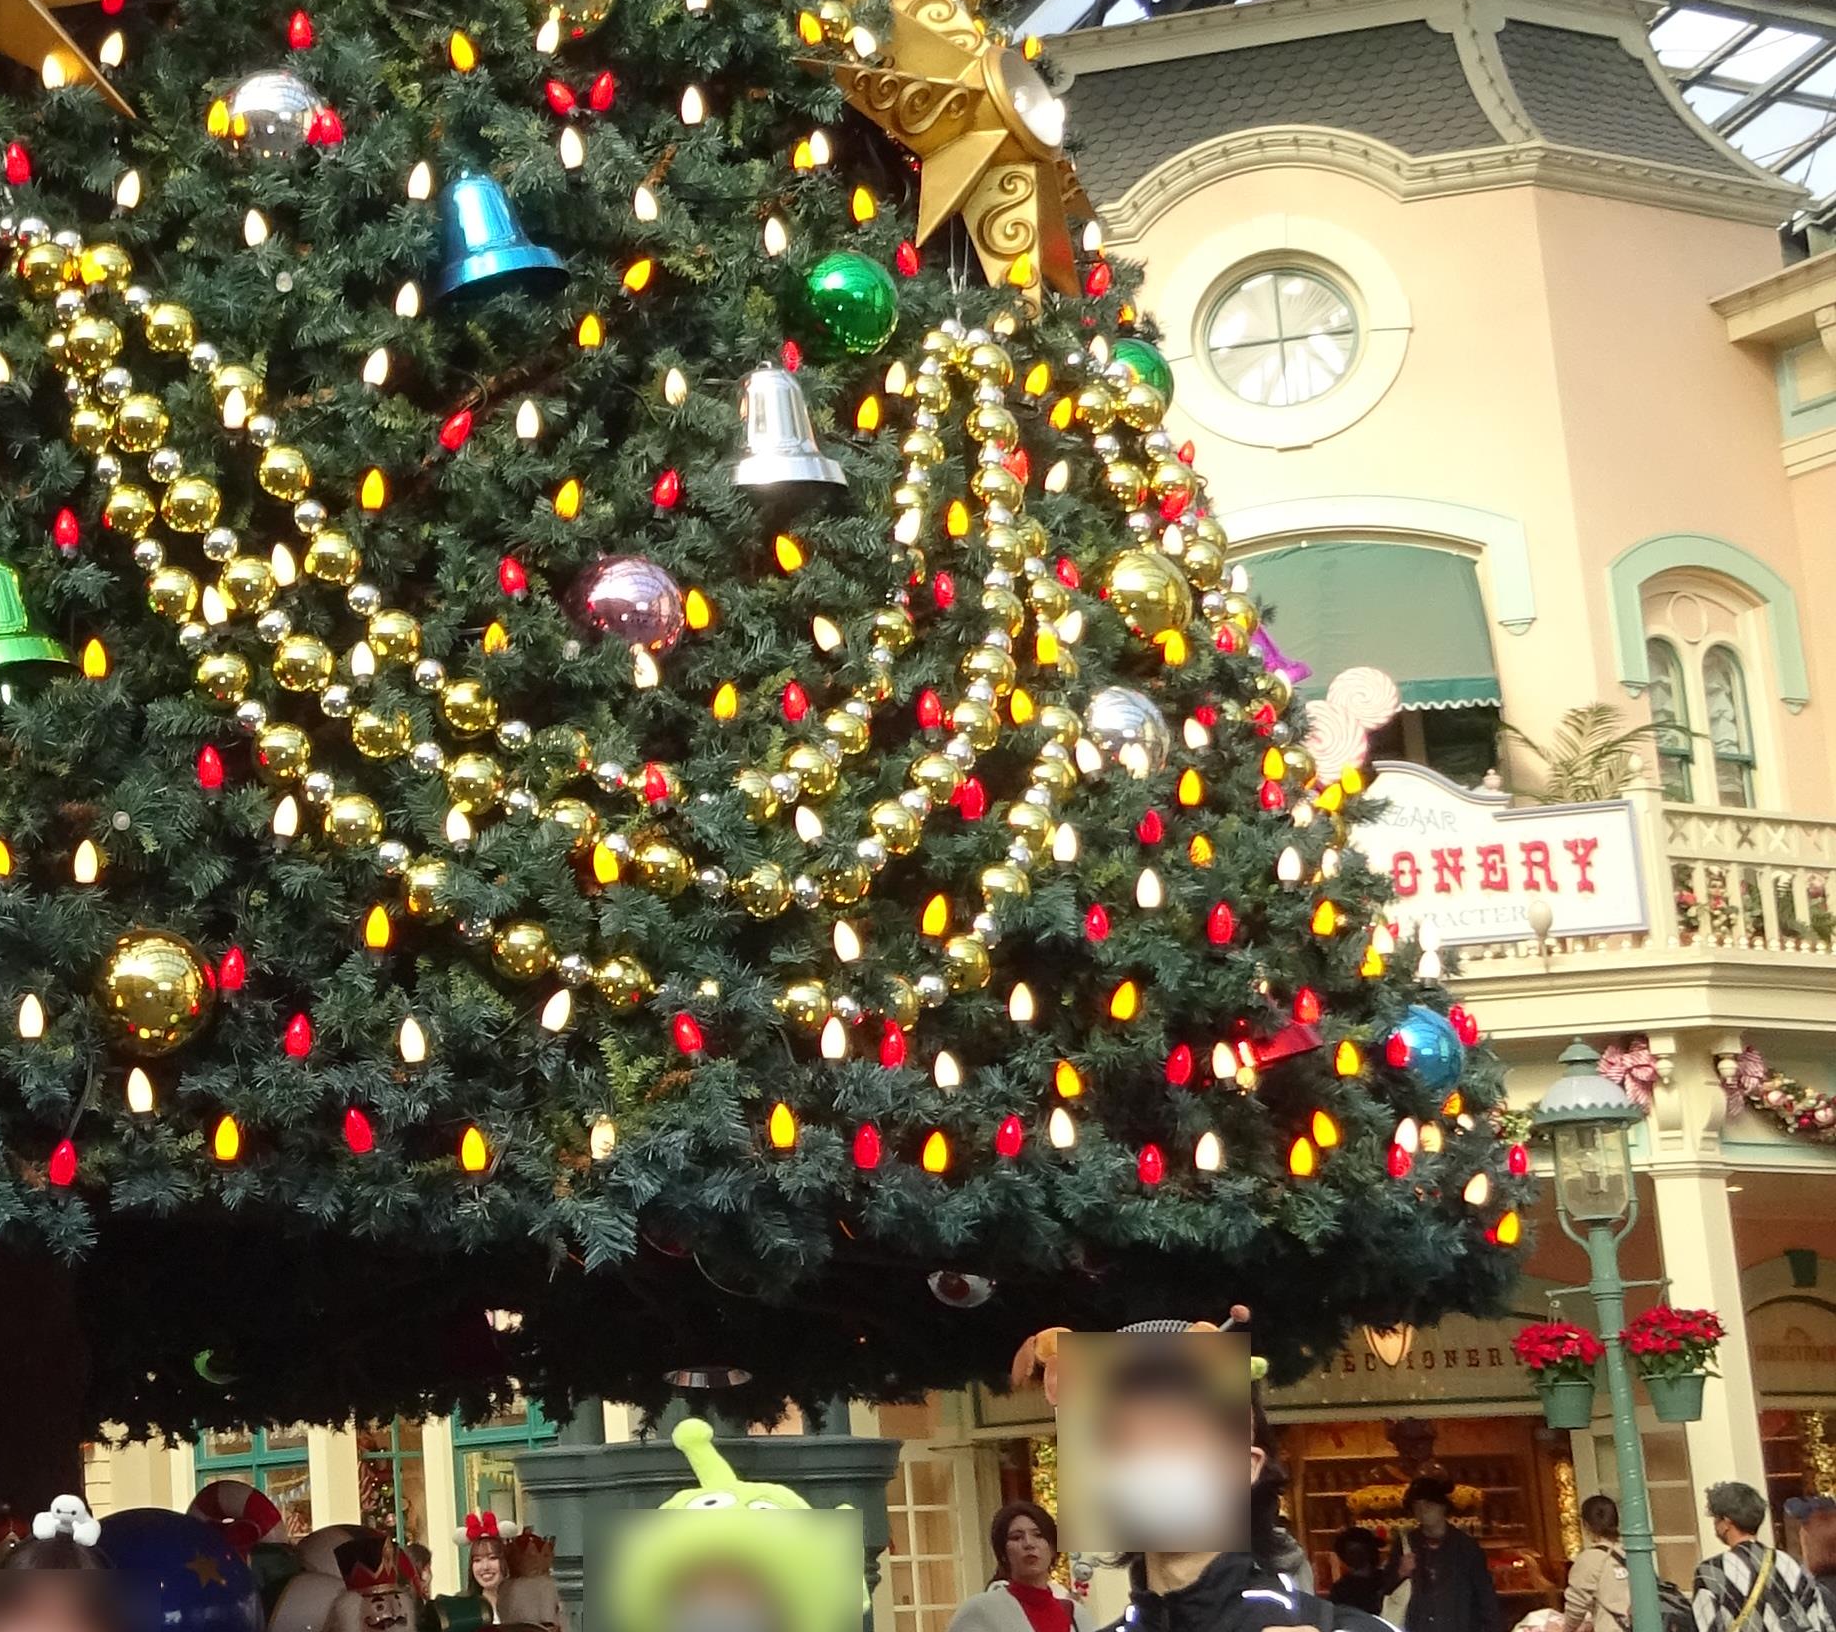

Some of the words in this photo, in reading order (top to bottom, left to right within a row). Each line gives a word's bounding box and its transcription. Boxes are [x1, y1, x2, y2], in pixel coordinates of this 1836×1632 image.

[1378, 804, 1459, 836] ZAAR
[1390, 837, 1598, 897] ONERY
[1395, 904, 1530, 931] RACTER
